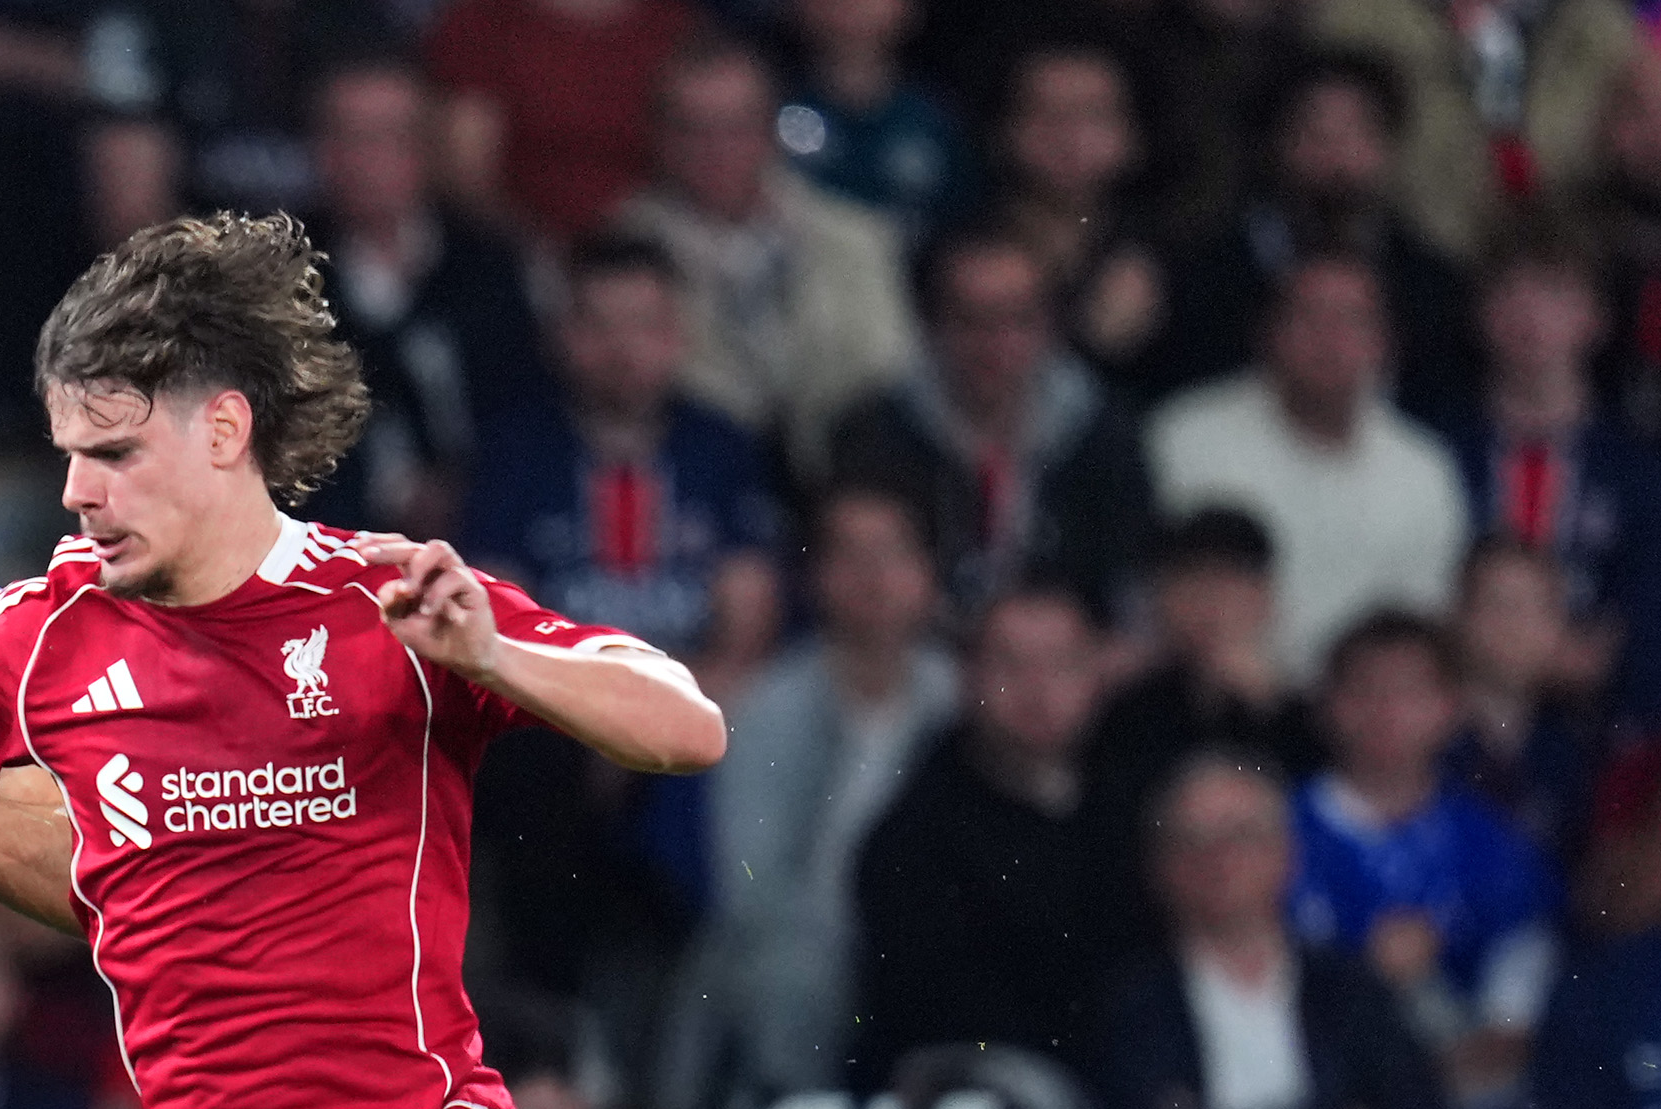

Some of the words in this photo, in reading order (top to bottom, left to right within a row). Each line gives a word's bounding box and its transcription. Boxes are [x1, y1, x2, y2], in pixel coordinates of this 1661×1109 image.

[286, 696, 339, 719] L.F.C.
[161, 756, 345, 801] standard
[164, 786, 357, 833] chartered
